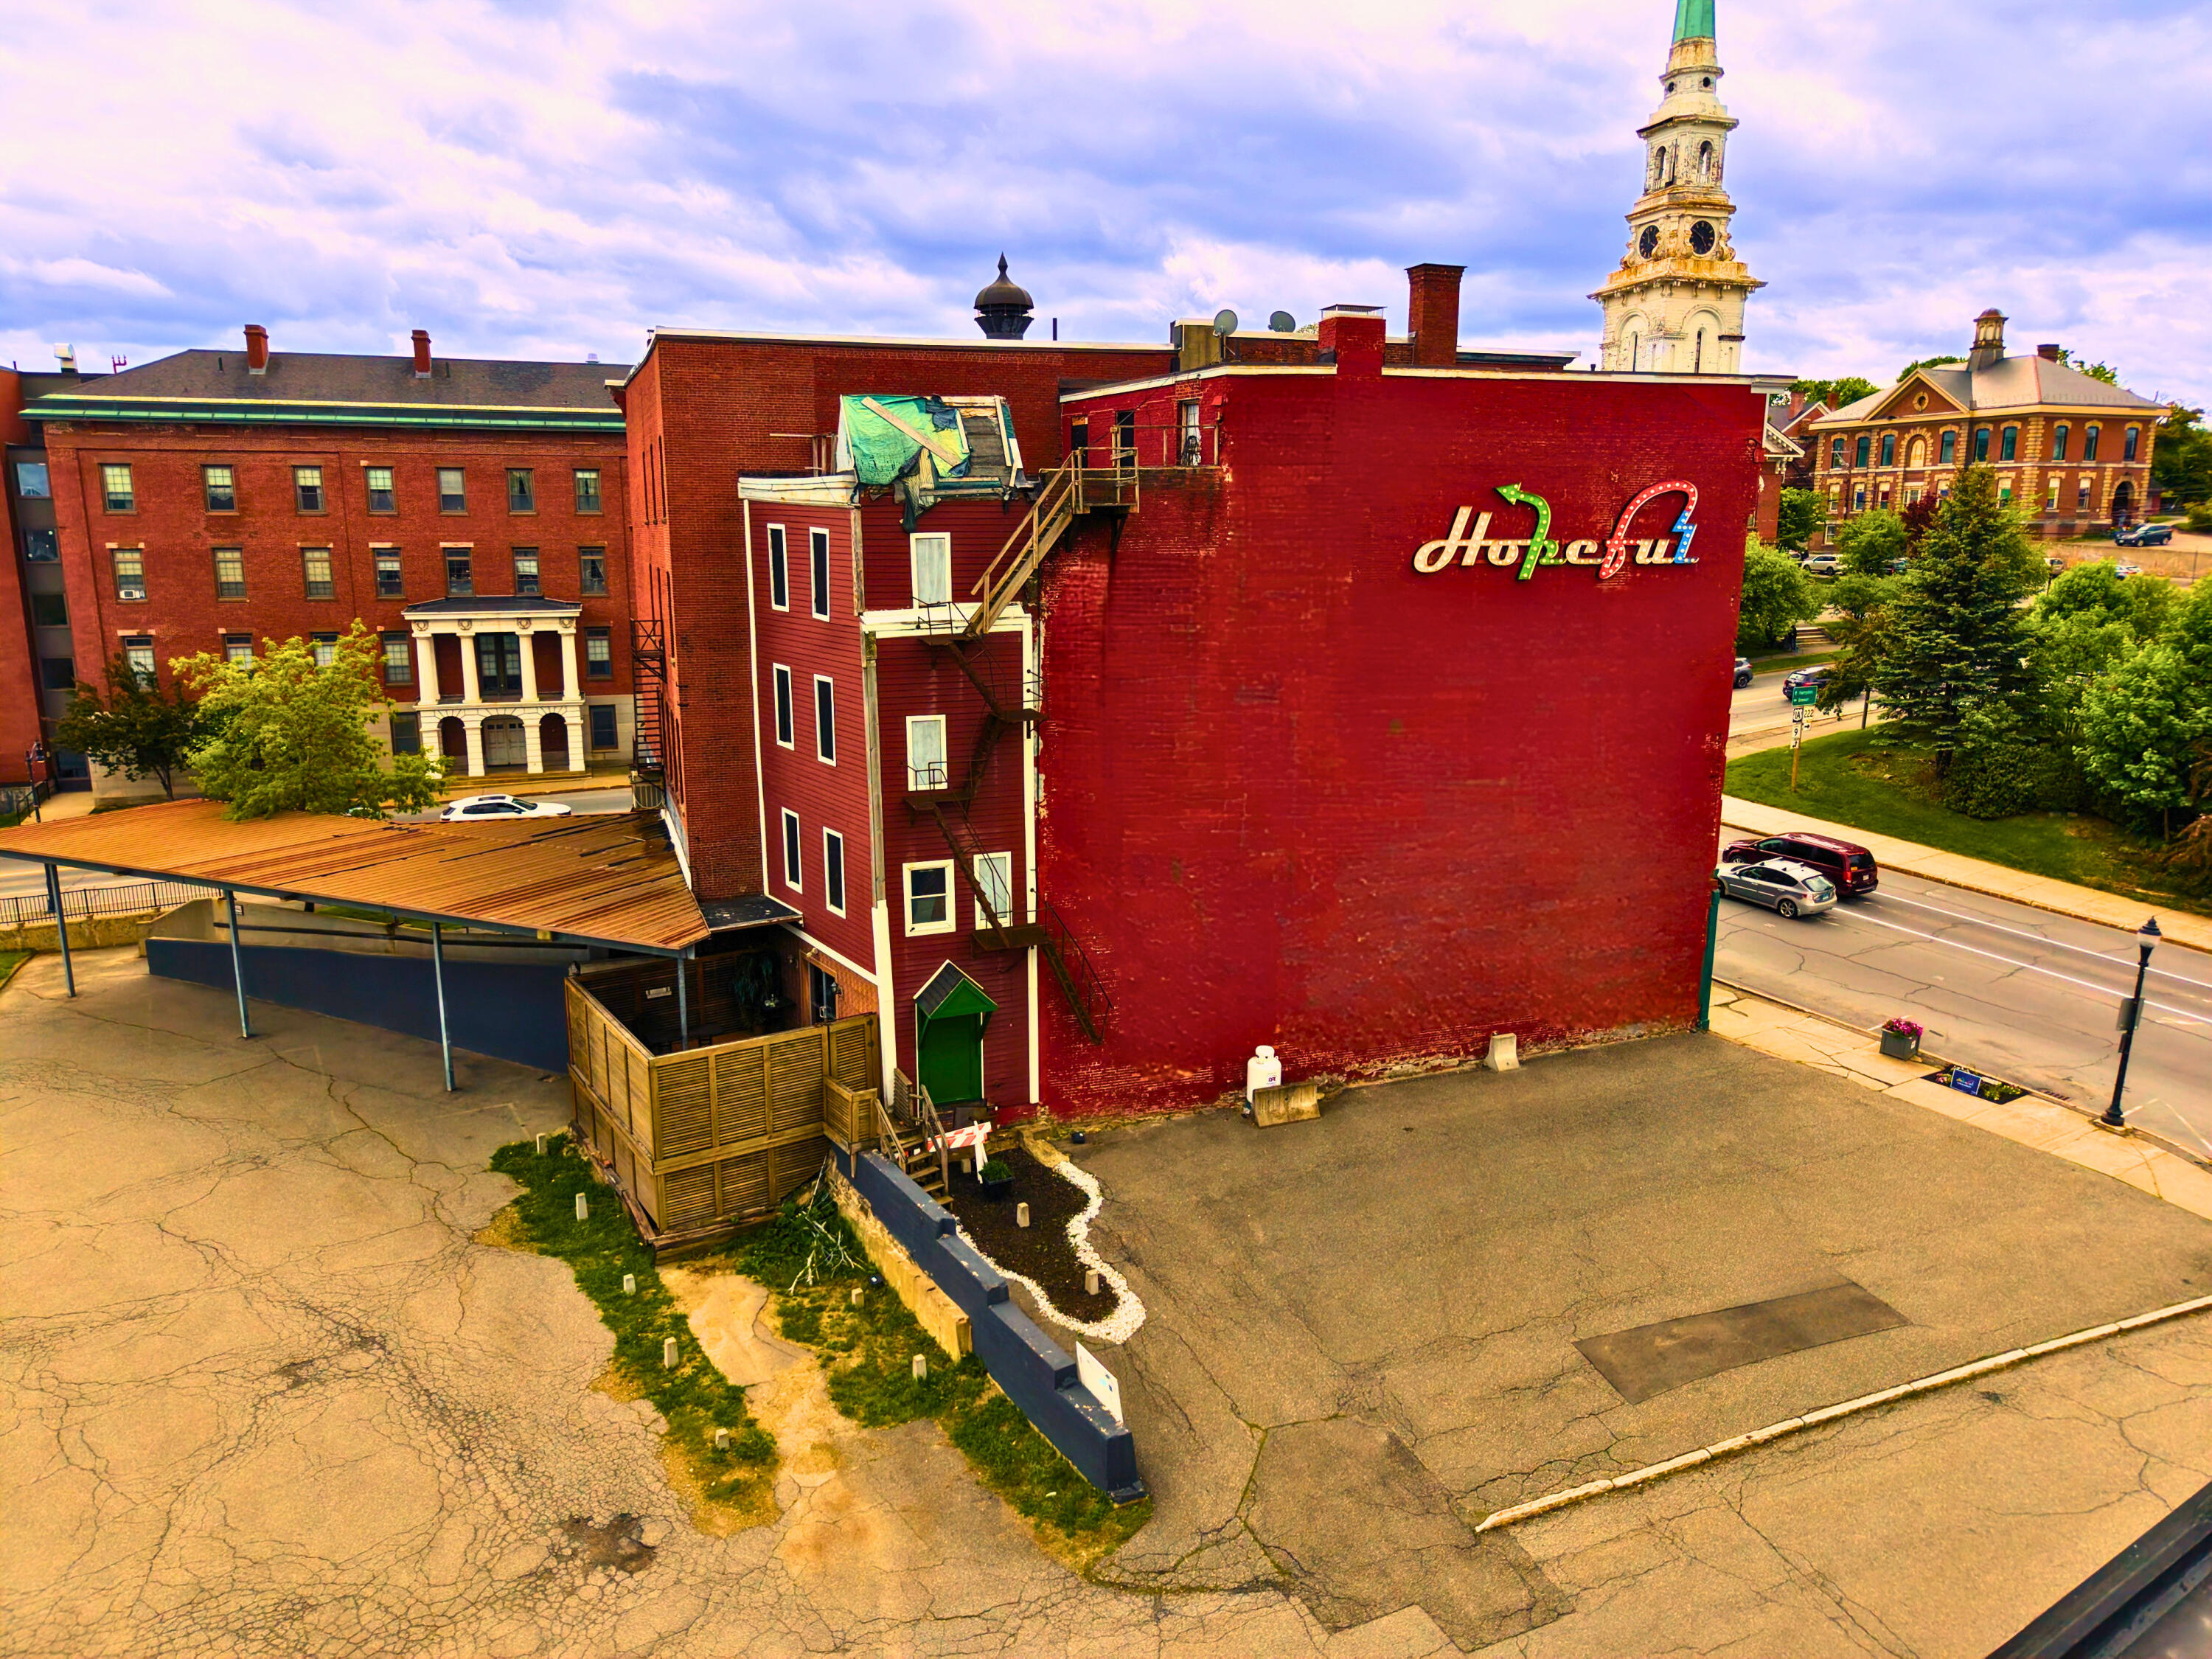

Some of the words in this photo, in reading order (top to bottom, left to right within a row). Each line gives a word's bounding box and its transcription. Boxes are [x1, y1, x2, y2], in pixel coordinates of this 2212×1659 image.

[1413, 480, 1699, 580] Hopeful
[1795, 711, 1801, 719] 1A
[1804, 709, 1814, 717] 222
[1794, 728, 1798, 736] 9
